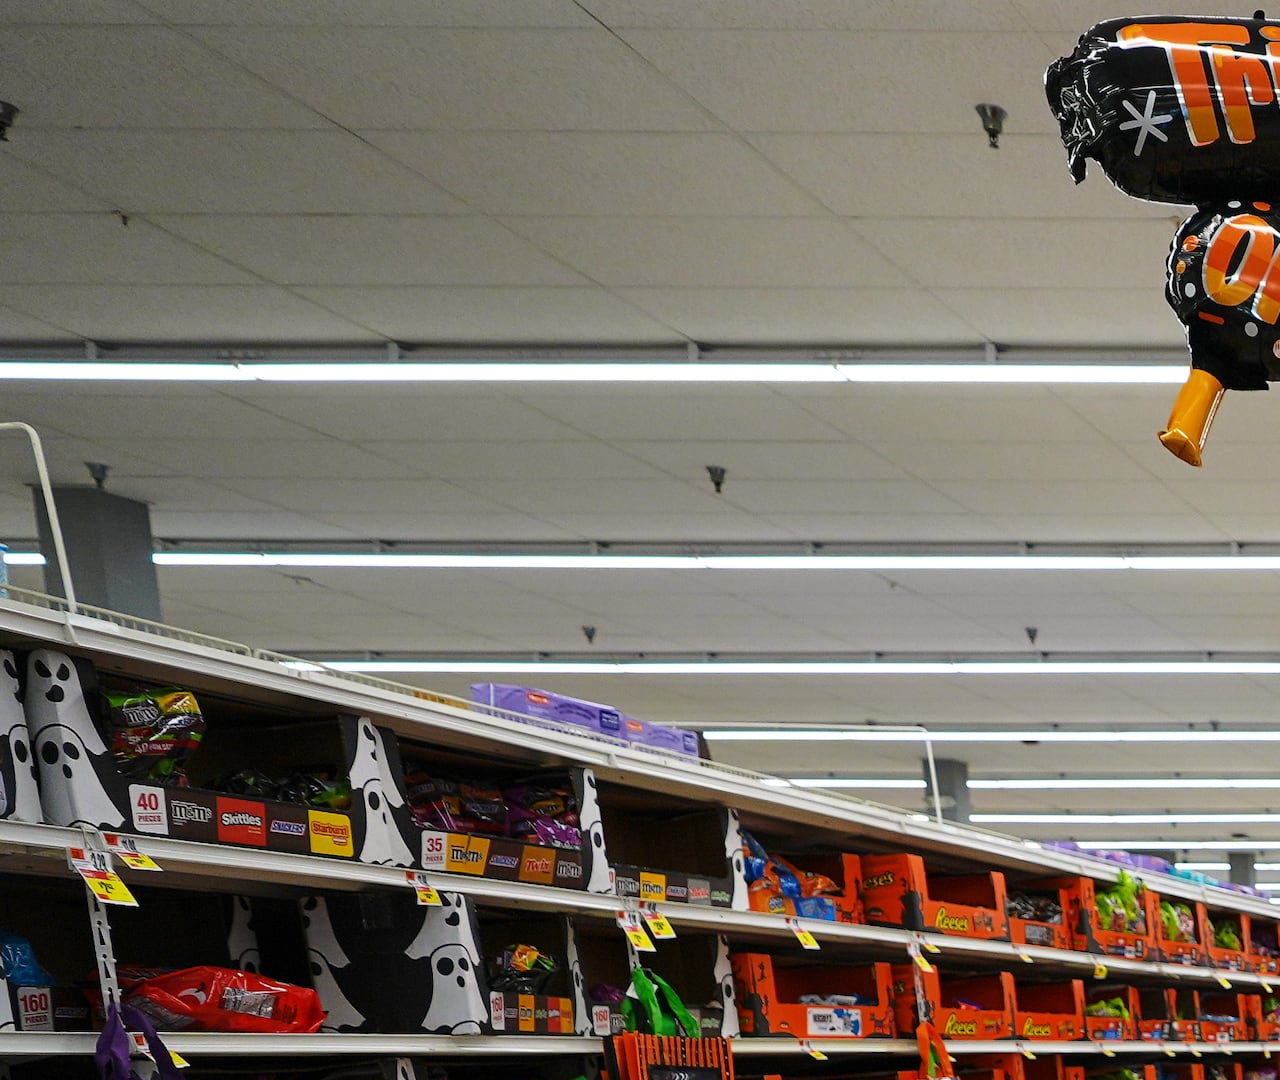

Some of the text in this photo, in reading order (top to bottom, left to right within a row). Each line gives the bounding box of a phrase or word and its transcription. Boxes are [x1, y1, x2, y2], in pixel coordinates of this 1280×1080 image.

[137, 793, 159, 811] 40
[221, 813, 262, 827] Skittles
[271, 821, 305, 835] SNICKERS
[311, 822, 349, 838] Starburst
[426, 838, 442, 853] 35
[935, 906, 969, 932] Reese's
[20, 992, 48, 1012] 160
[944, 1014, 977, 1036] Reese's
[1023, 1017, 1052, 1037] Reese's
